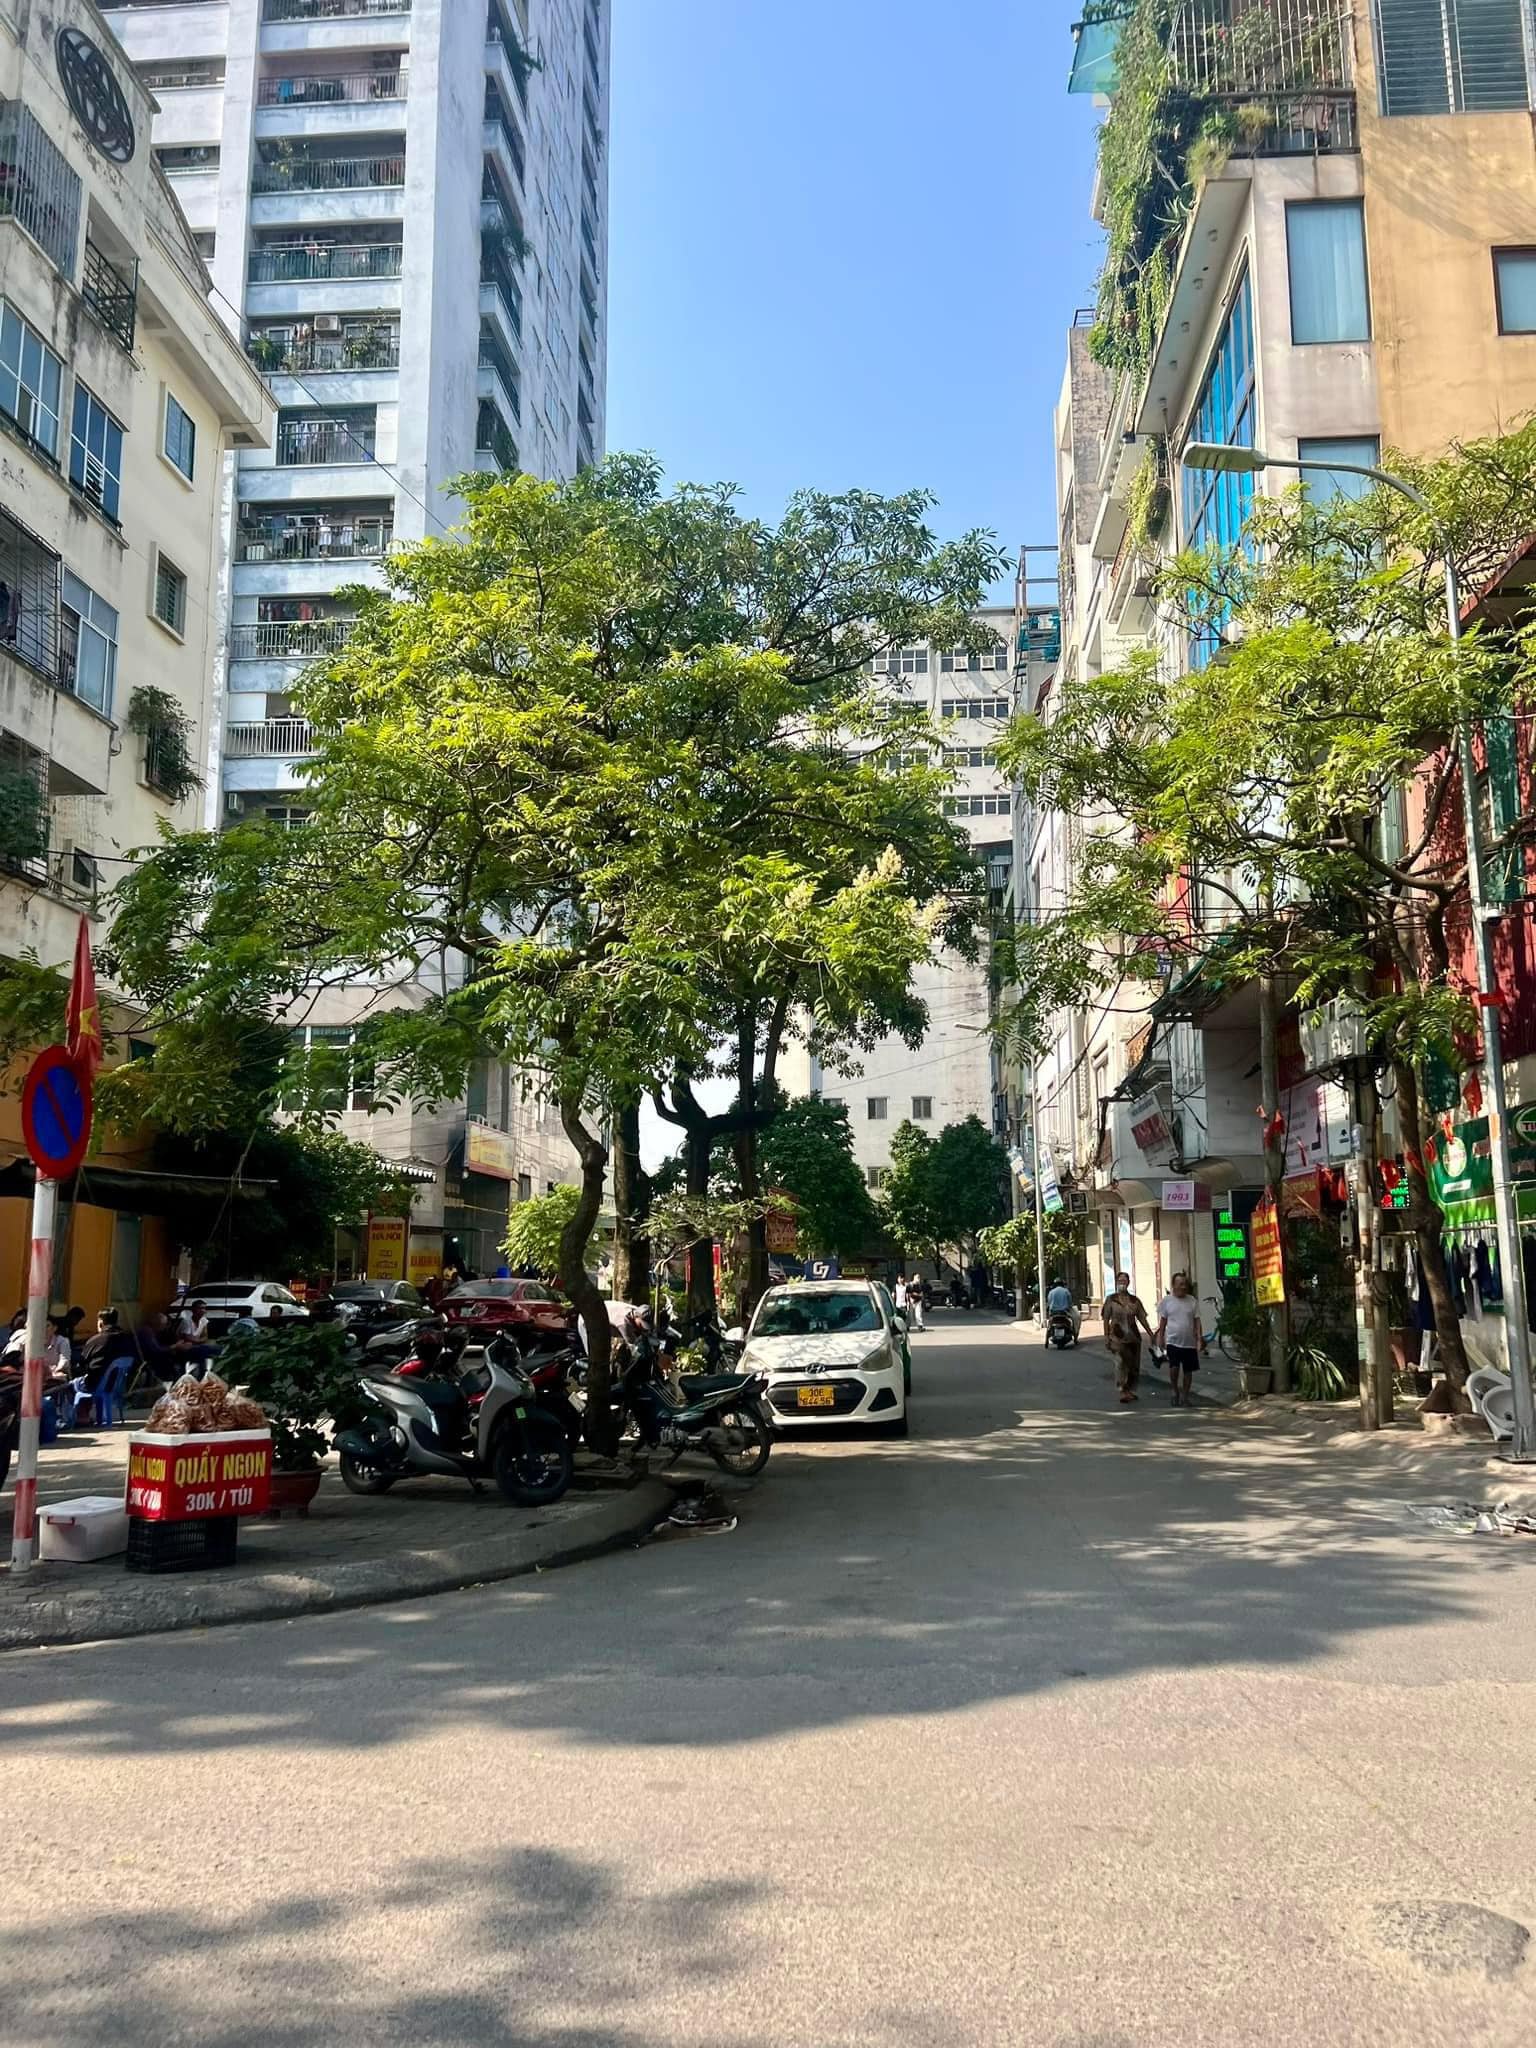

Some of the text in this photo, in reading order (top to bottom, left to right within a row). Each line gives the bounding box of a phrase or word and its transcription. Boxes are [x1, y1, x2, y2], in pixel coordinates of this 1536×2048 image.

[223, 1451, 266, 1480] NGON
[186, 1491, 216, 1511] 30K
[230, 1484, 252, 1506] TÚI
